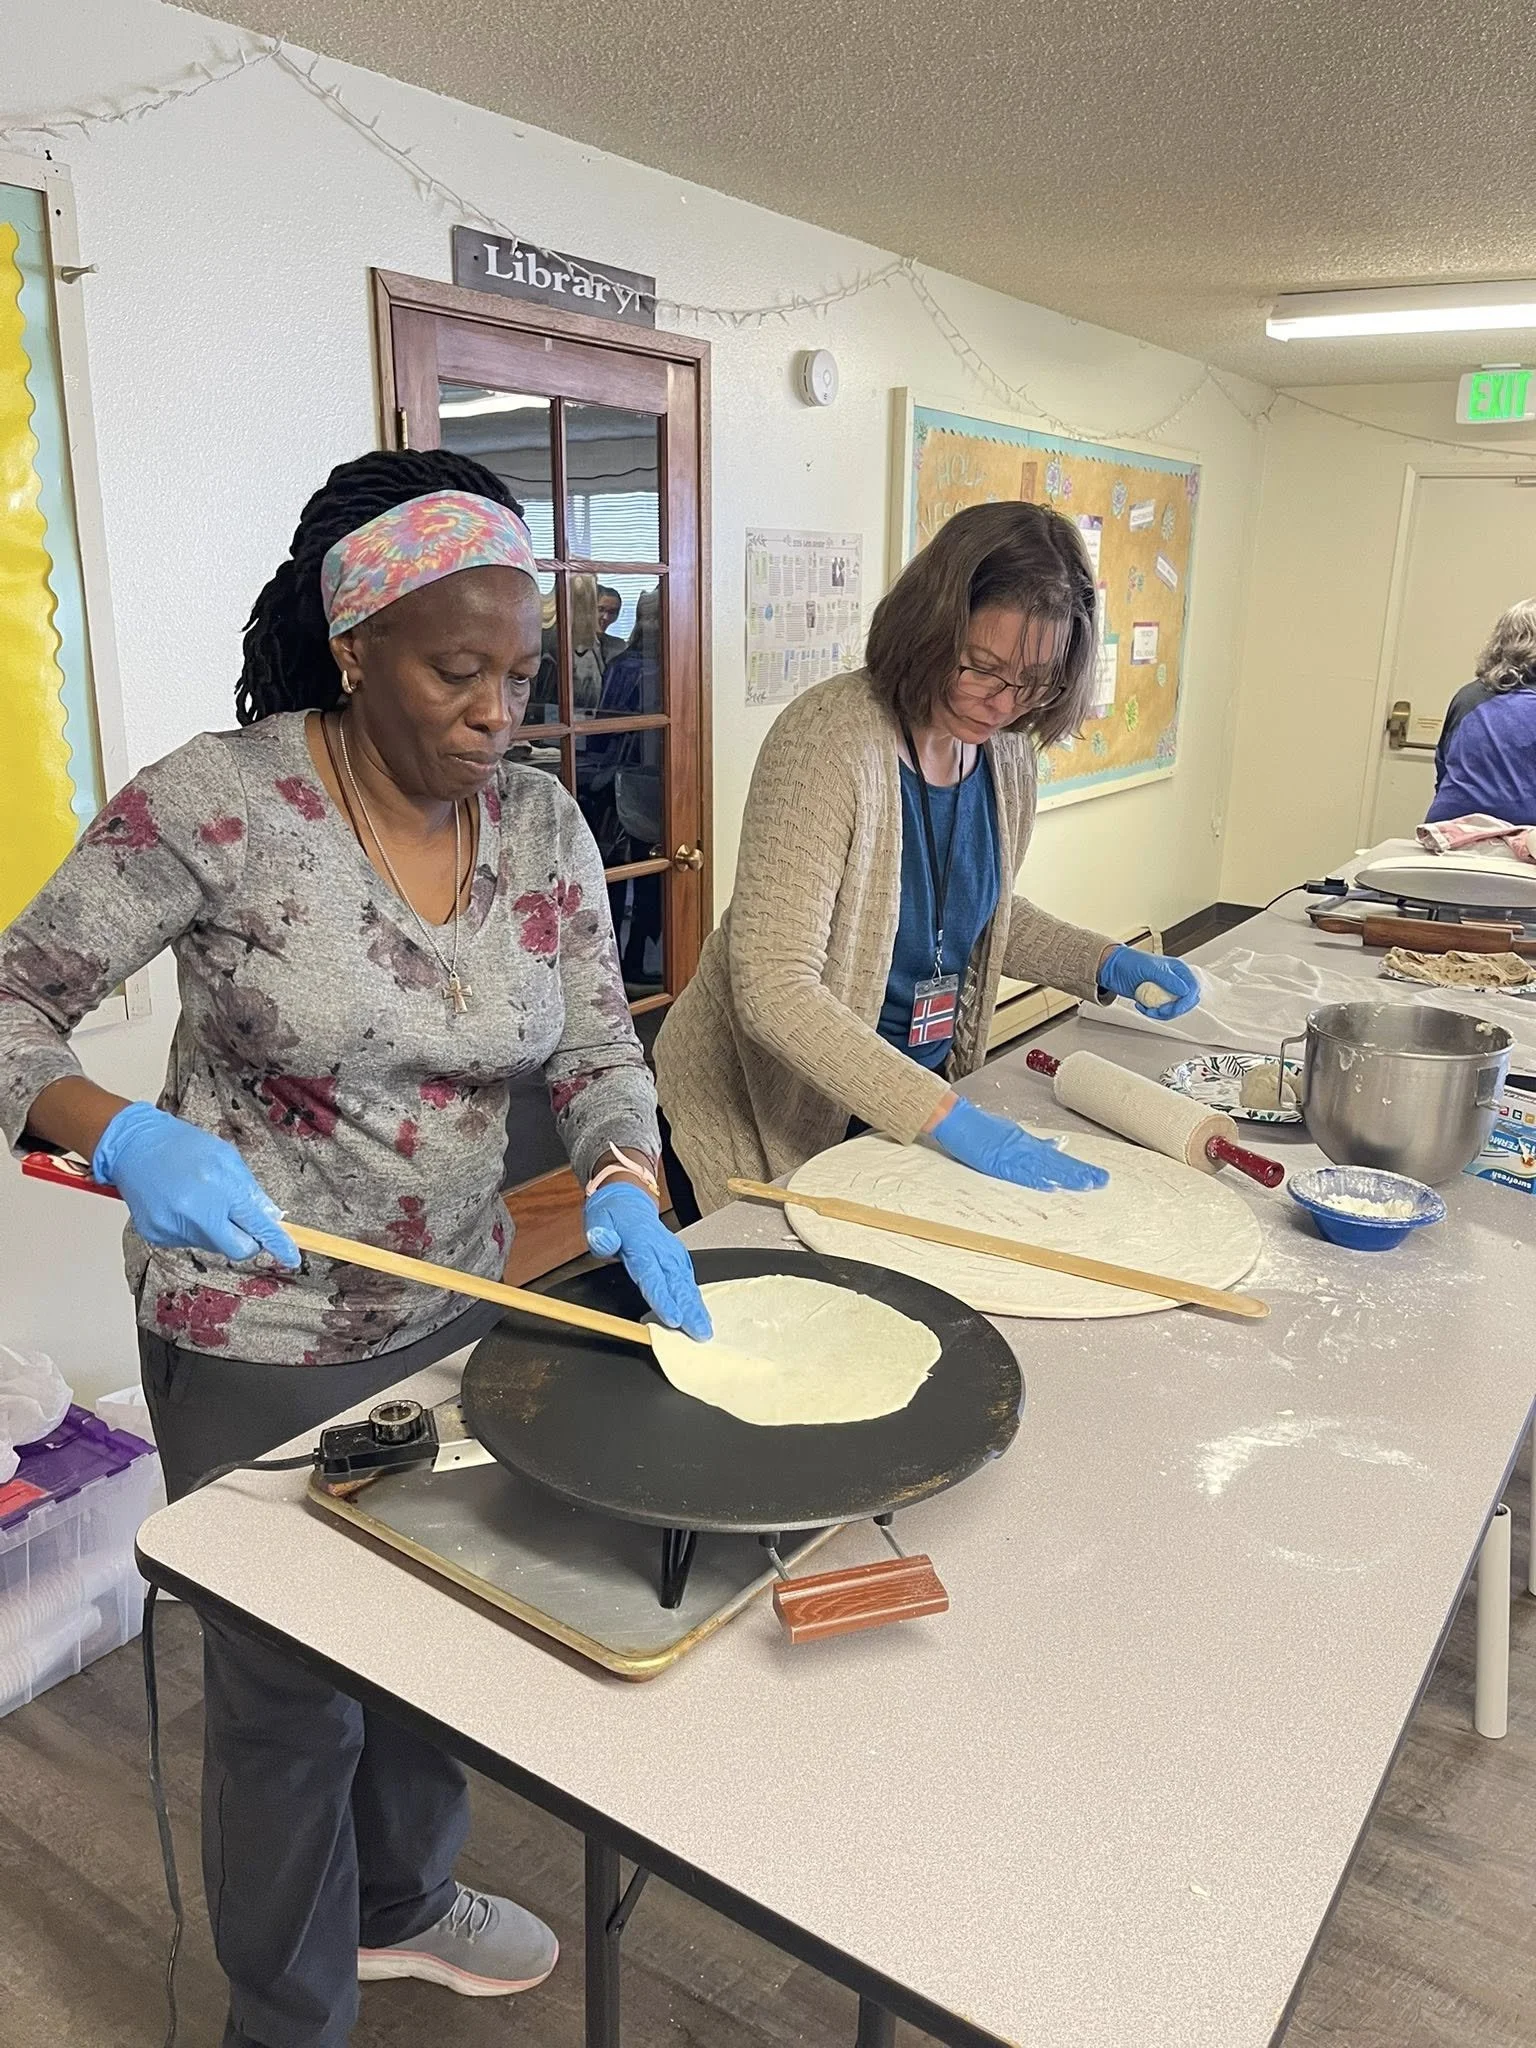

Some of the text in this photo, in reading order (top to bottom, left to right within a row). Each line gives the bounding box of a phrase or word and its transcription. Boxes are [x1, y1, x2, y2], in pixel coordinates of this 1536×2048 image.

[483, 244, 634, 315] Library
[1468, 371, 1533, 419] EXIT
[1491, 1170, 1532, 1189] surefresh
